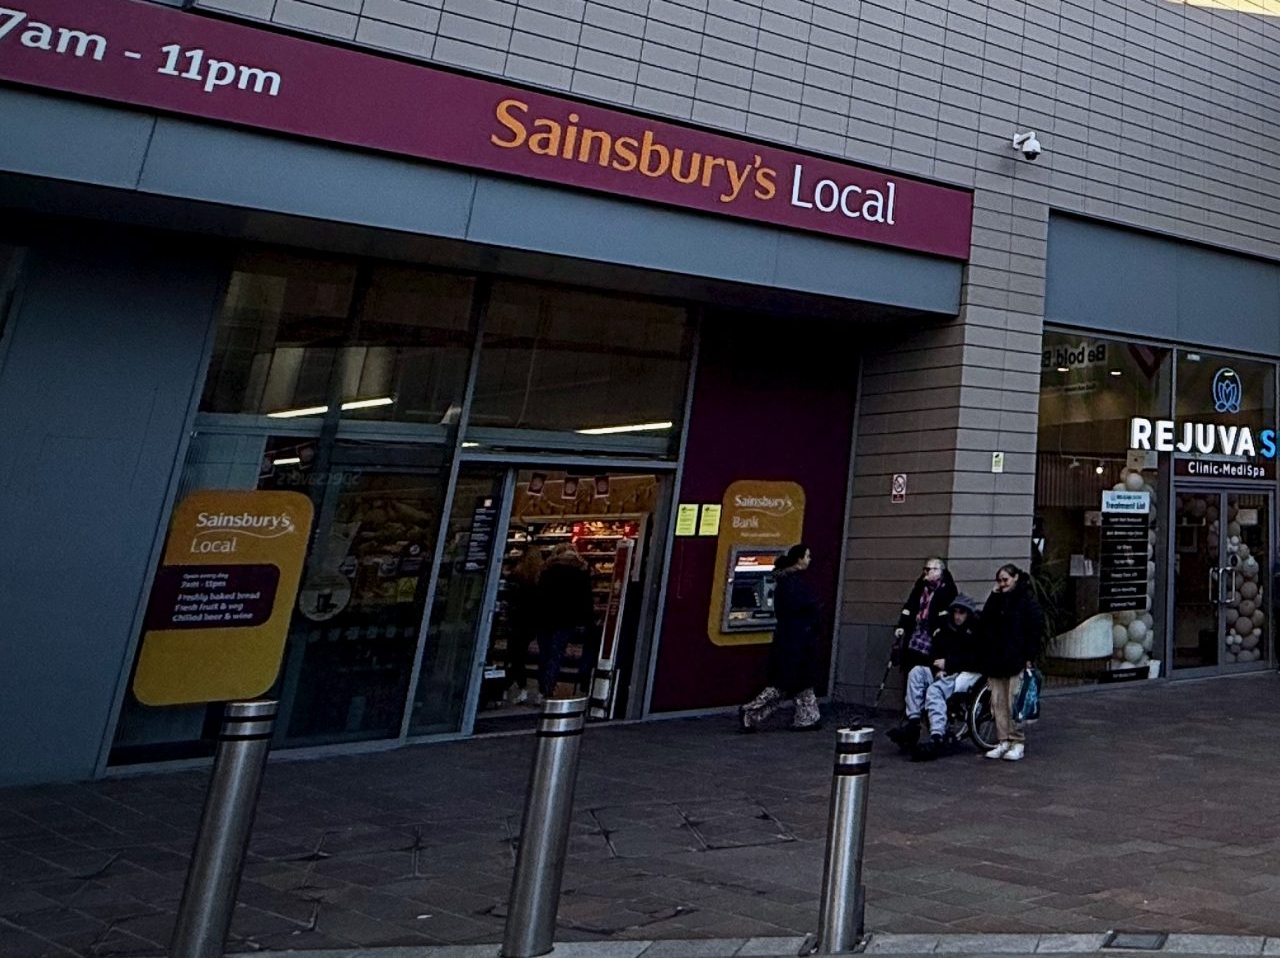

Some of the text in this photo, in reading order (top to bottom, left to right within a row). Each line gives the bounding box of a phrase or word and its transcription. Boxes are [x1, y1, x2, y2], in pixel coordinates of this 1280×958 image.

[0, 6, 108, 61] 7am
[158, 43, 282, 98] 11pm
[490, 99, 897, 225] Sainsbury's Local
[1130, 417, 1256, 456] REJUVA
[734, 494, 793, 510] Sainsbury's
[196, 512, 291, 530] Sainsbury's
[732, 515, 759, 529] Bank
[190, 536, 238, 553] Local
[209, 592, 236, 601] baked
